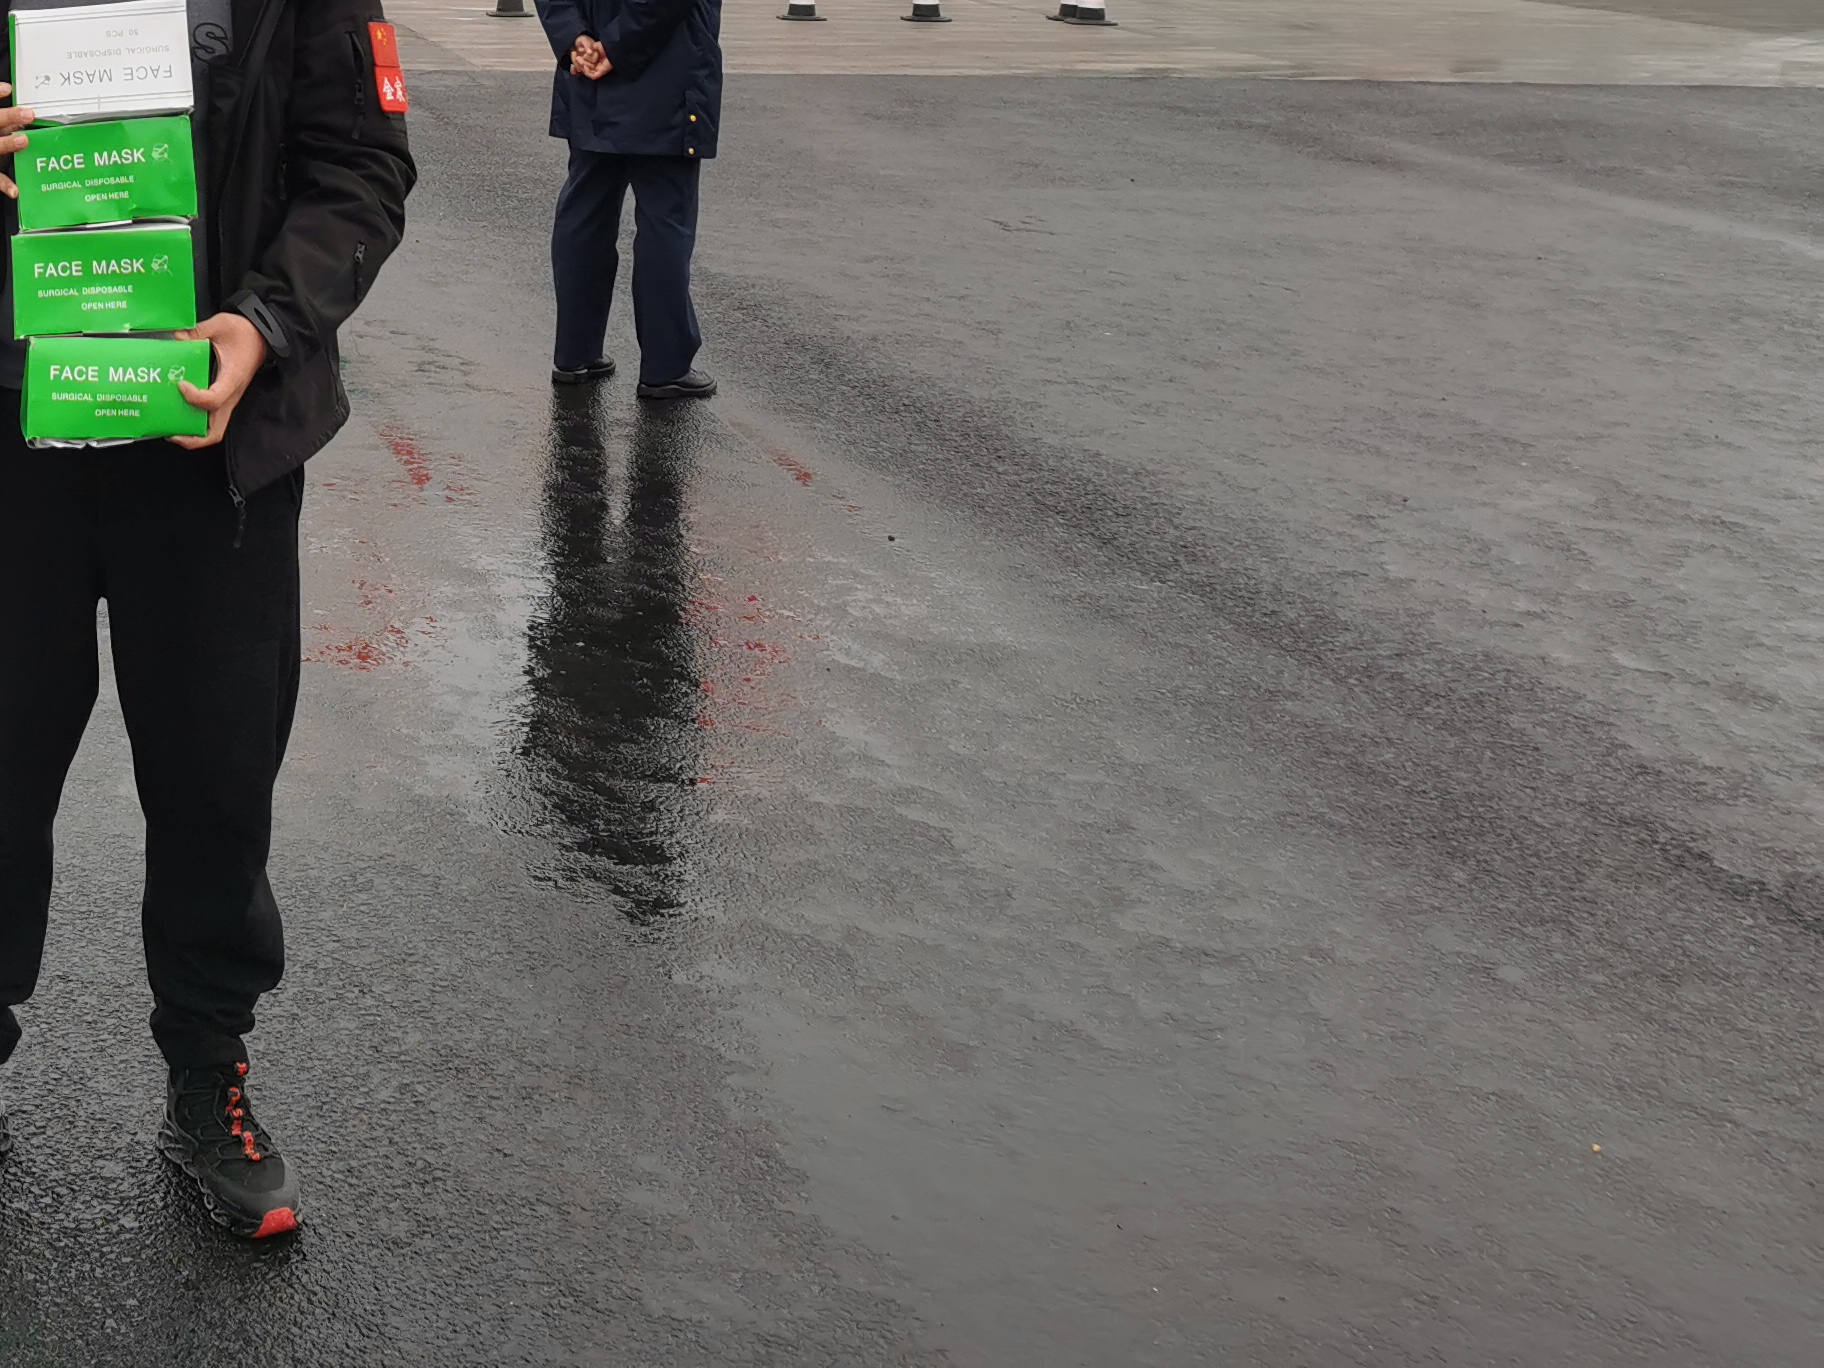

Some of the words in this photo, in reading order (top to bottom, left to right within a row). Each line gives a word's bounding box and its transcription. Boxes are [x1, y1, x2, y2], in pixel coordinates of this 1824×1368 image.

[106, 29, 125, 38] PCS
[66, 48, 122, 59] DISPOSABLE
[126, 44, 170, 54] SURGICAL
[59, 68, 113, 86] MASK
[122, 64, 174, 82] FACE
[36, 153, 85, 173] FACE
[94, 147, 146, 167] MASK
[41, 180, 82, 192] SURGICAL
[85, 175, 135, 187] DISPOSABLE
[85, 192, 107, 202] OPEN
[108, 191, 129, 200] HERE
[34, 261, 83, 278] FACE
[92, 258, 146, 275] MASK
[37, 288, 79, 298] SURGICAL
[82, 285, 133, 295] DISPOSABLE
[81, 301, 104, 311] OPEN
[105, 300, 127, 309] HERE
[49, 365, 99, 382] FACE
[108, 366, 161, 383] MASK
[51, 392, 94, 401] SURGICAL
[96, 393, 148, 403] DISPOSABLE
[95, 409, 117, 417] OPEN
[118, 409, 140, 417] HERE
